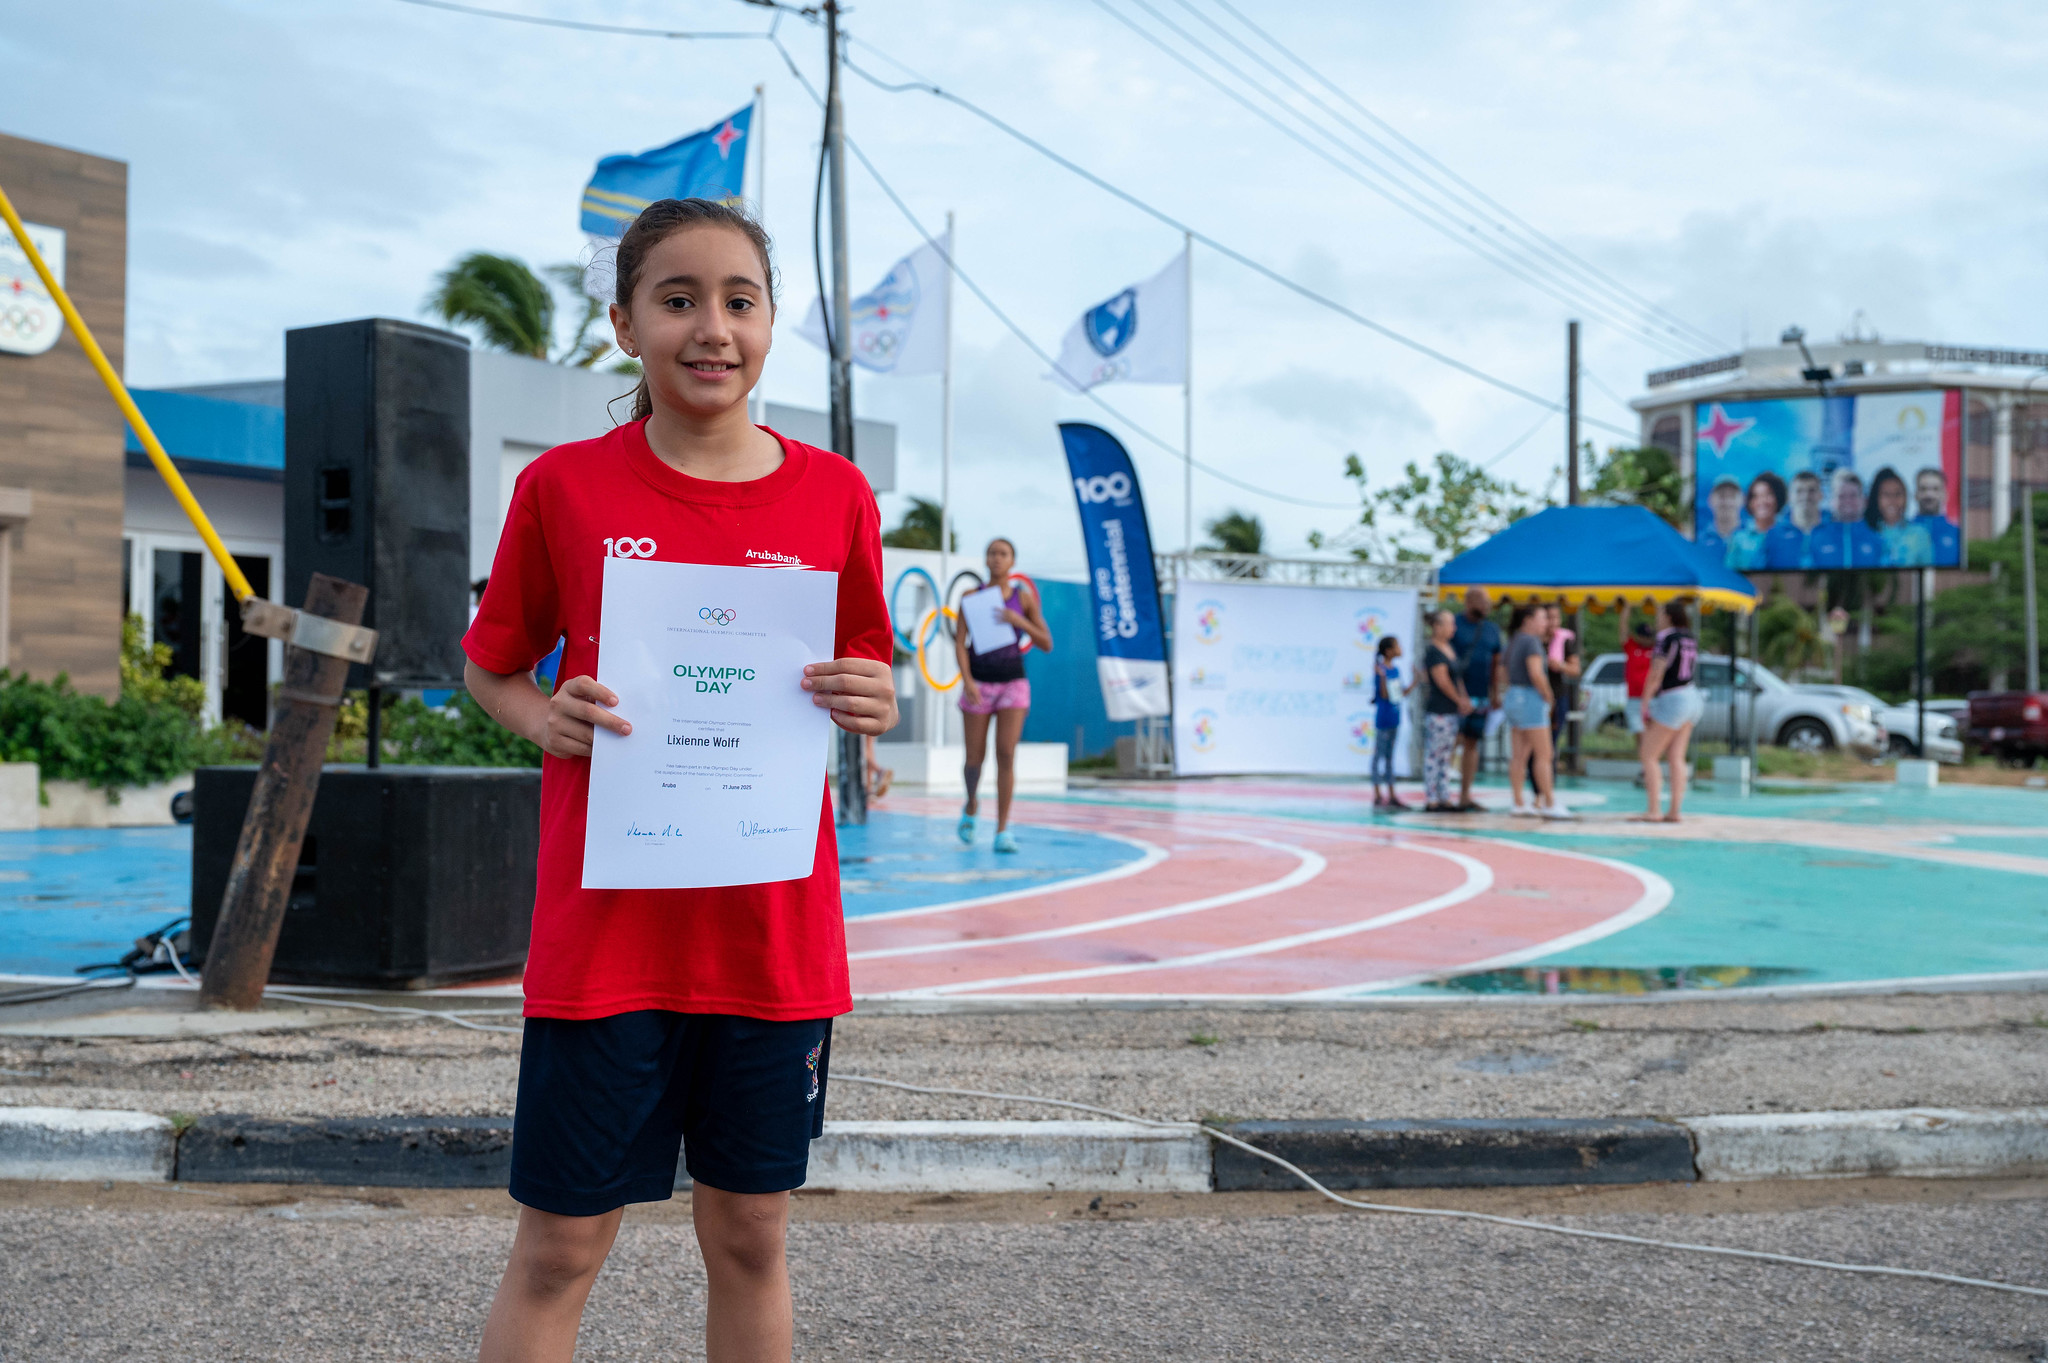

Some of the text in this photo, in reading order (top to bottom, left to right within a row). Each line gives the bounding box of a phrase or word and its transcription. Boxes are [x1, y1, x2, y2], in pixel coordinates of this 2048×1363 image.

[1075, 471, 1132, 504] 100
[604, 536, 657, 558] 100
[746, 549, 802, 566] Arubabank
[673, 664, 756, 681] OLYMPIC
[695, 681, 732, 694] DAY
[667, 734, 740, 748] Lixienne Wolff
